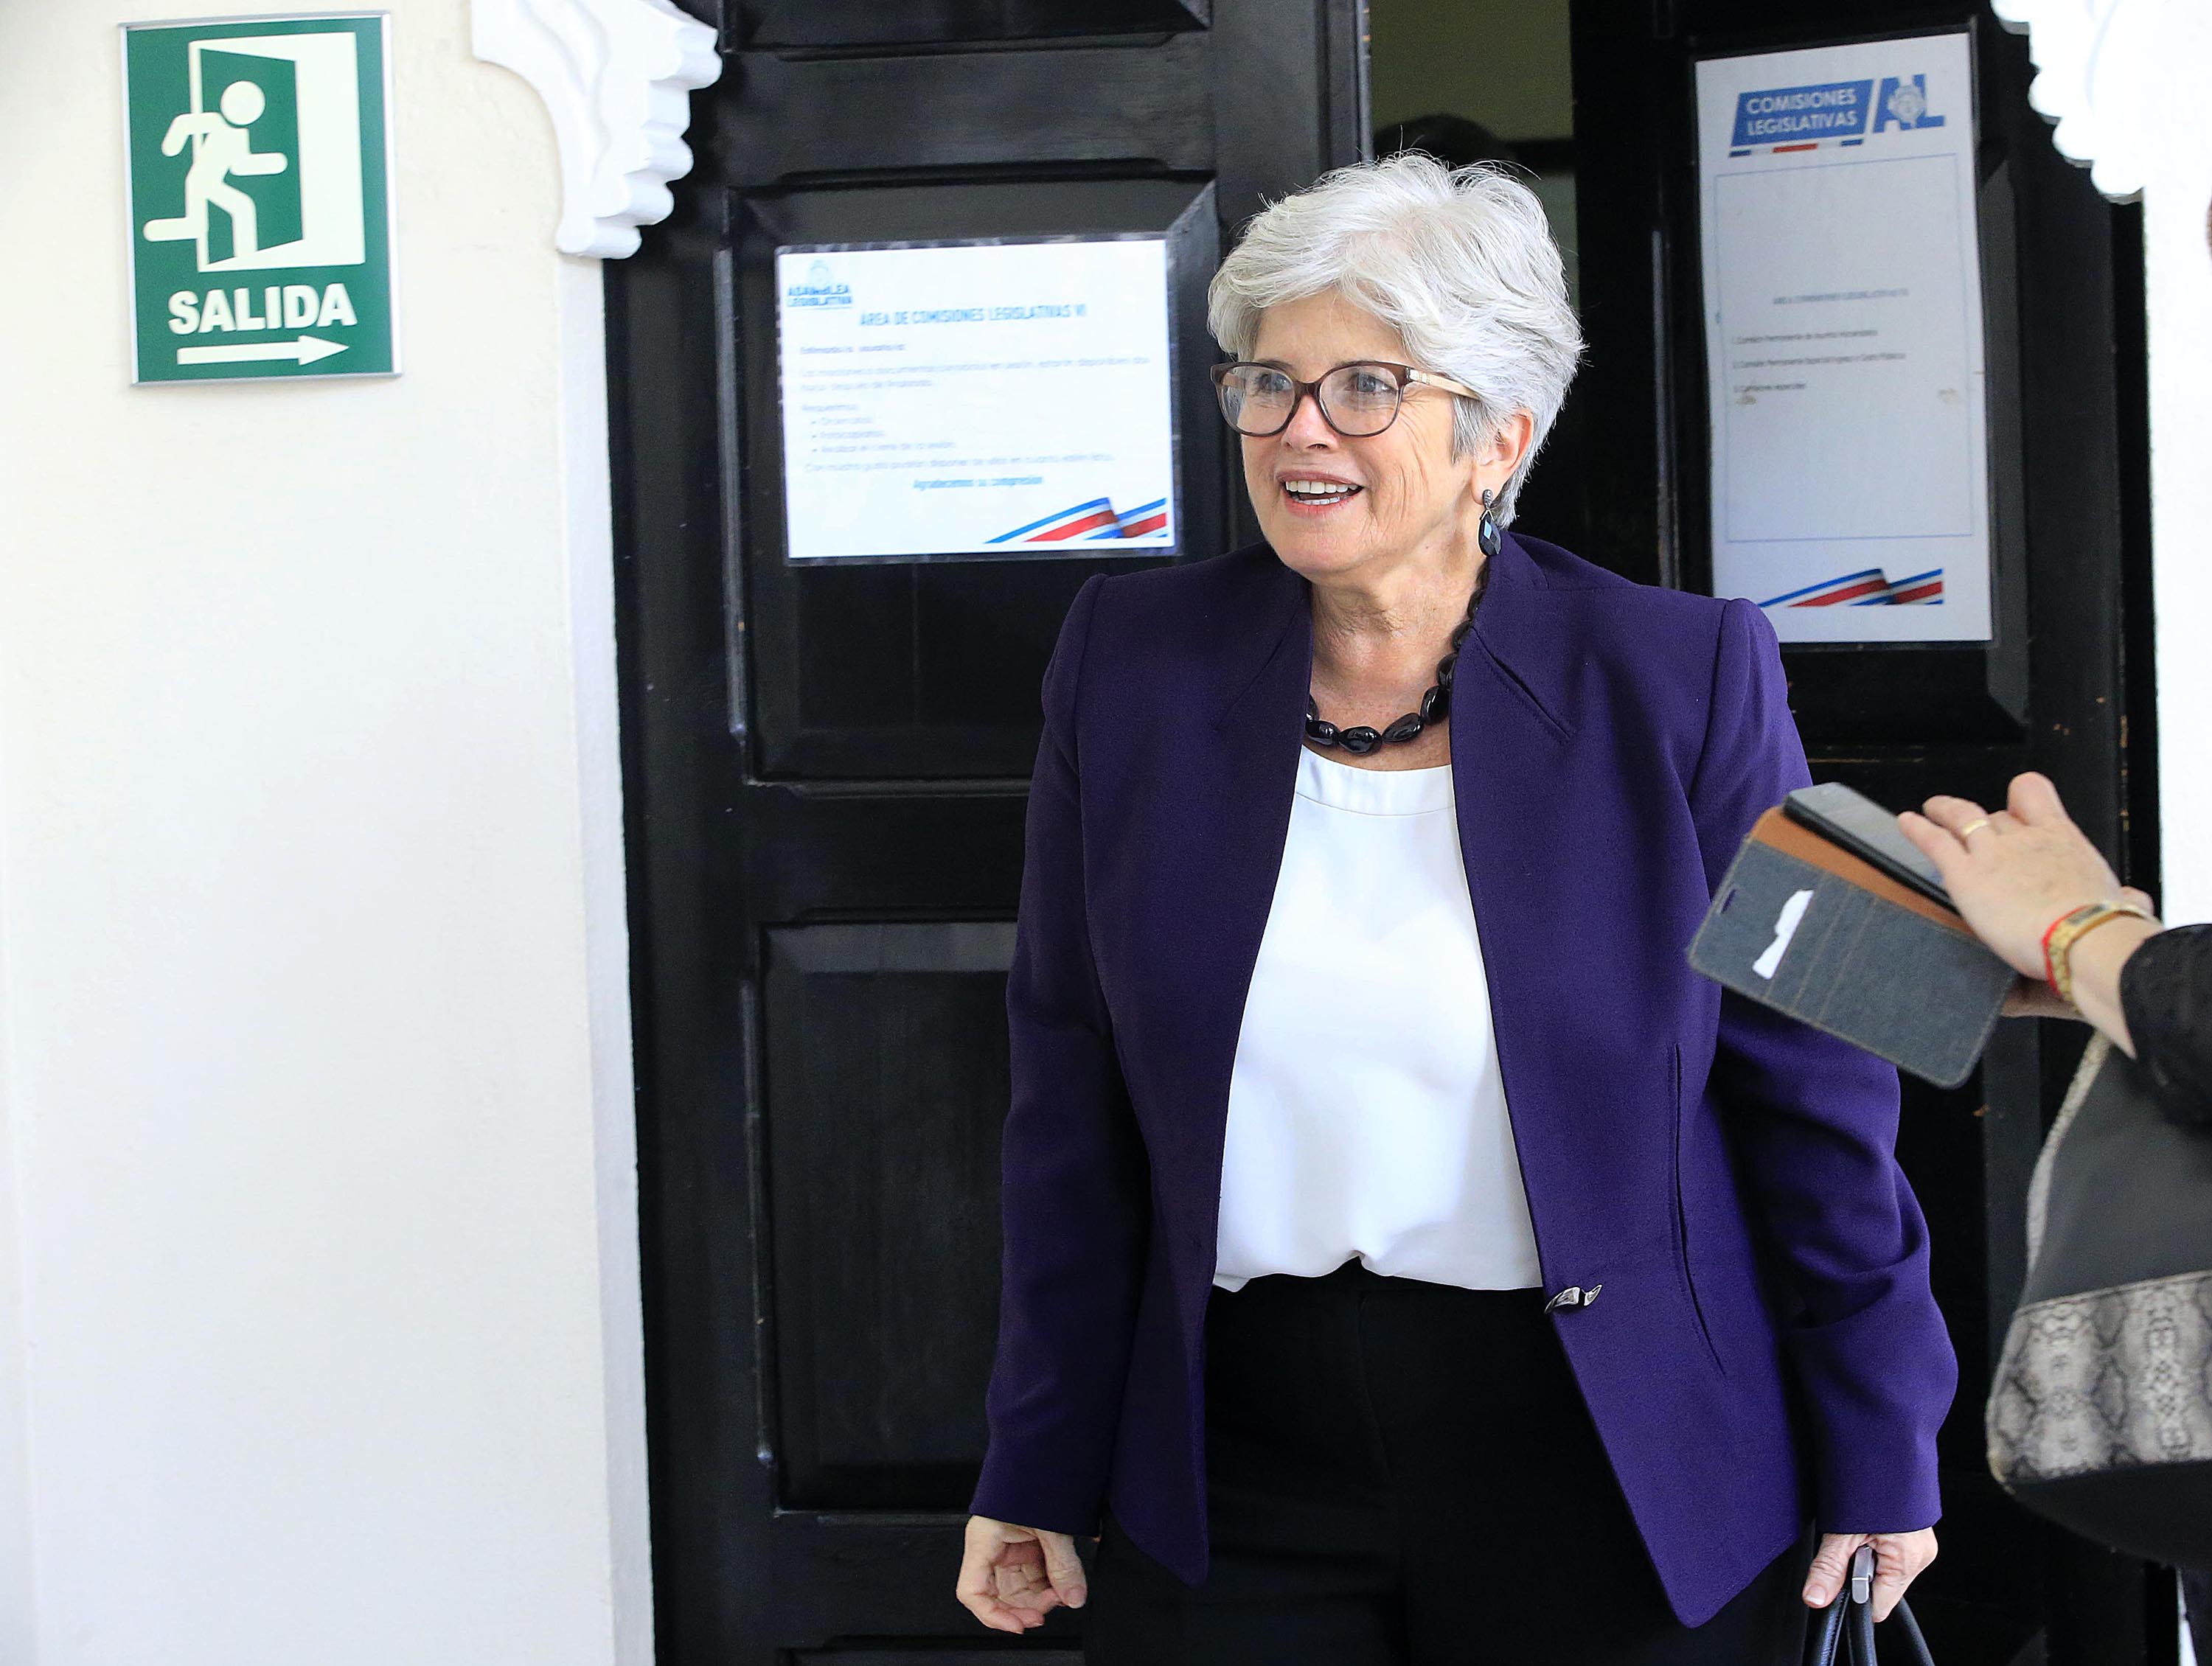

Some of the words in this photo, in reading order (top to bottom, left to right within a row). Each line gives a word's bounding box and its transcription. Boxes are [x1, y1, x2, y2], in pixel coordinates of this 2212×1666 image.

[1746, 88, 1857, 114] COMISIONES
[1747, 110, 1857, 136] LEGISLATIVAS
[168, 283, 358, 335] SALIDA
[894, 310, 909, 325] DE
[913, 307, 985, 324] COMISIONES
[989, 304, 1071, 321] LEGISLATIVAS
